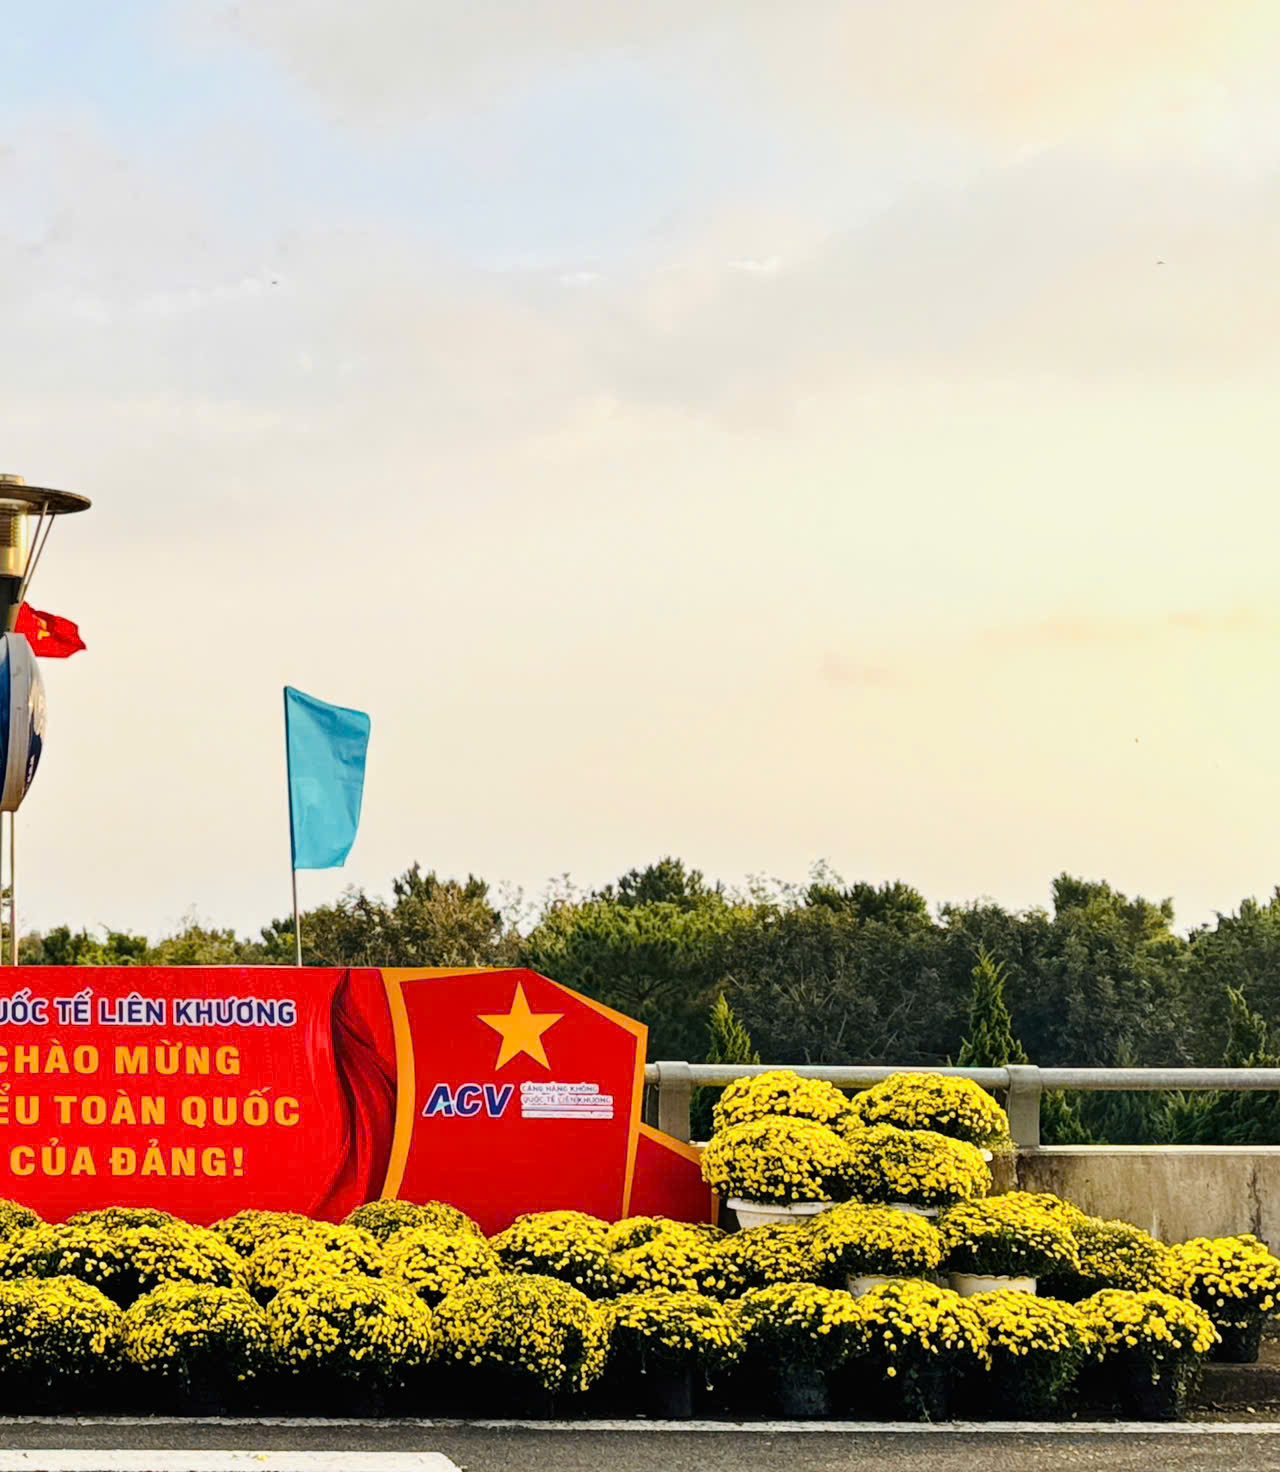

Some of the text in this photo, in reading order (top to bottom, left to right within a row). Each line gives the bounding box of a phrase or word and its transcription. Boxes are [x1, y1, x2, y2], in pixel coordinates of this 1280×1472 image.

[56, 989, 91, 1024] TẾ
[100, 993, 165, 1024] LIÊN
[175, 997, 294, 1024] KHƯƠNG
[115, 1039, 240, 1074] MỪNG
[54, 1089, 165, 1124] TOÀN
[182, 1087, 299, 1128] QUỐC
[423, 1084, 514, 1116] ACV
[10, 1137, 96, 1175] CỦA
[109, 1138, 243, 1176] ĐẢNG!
